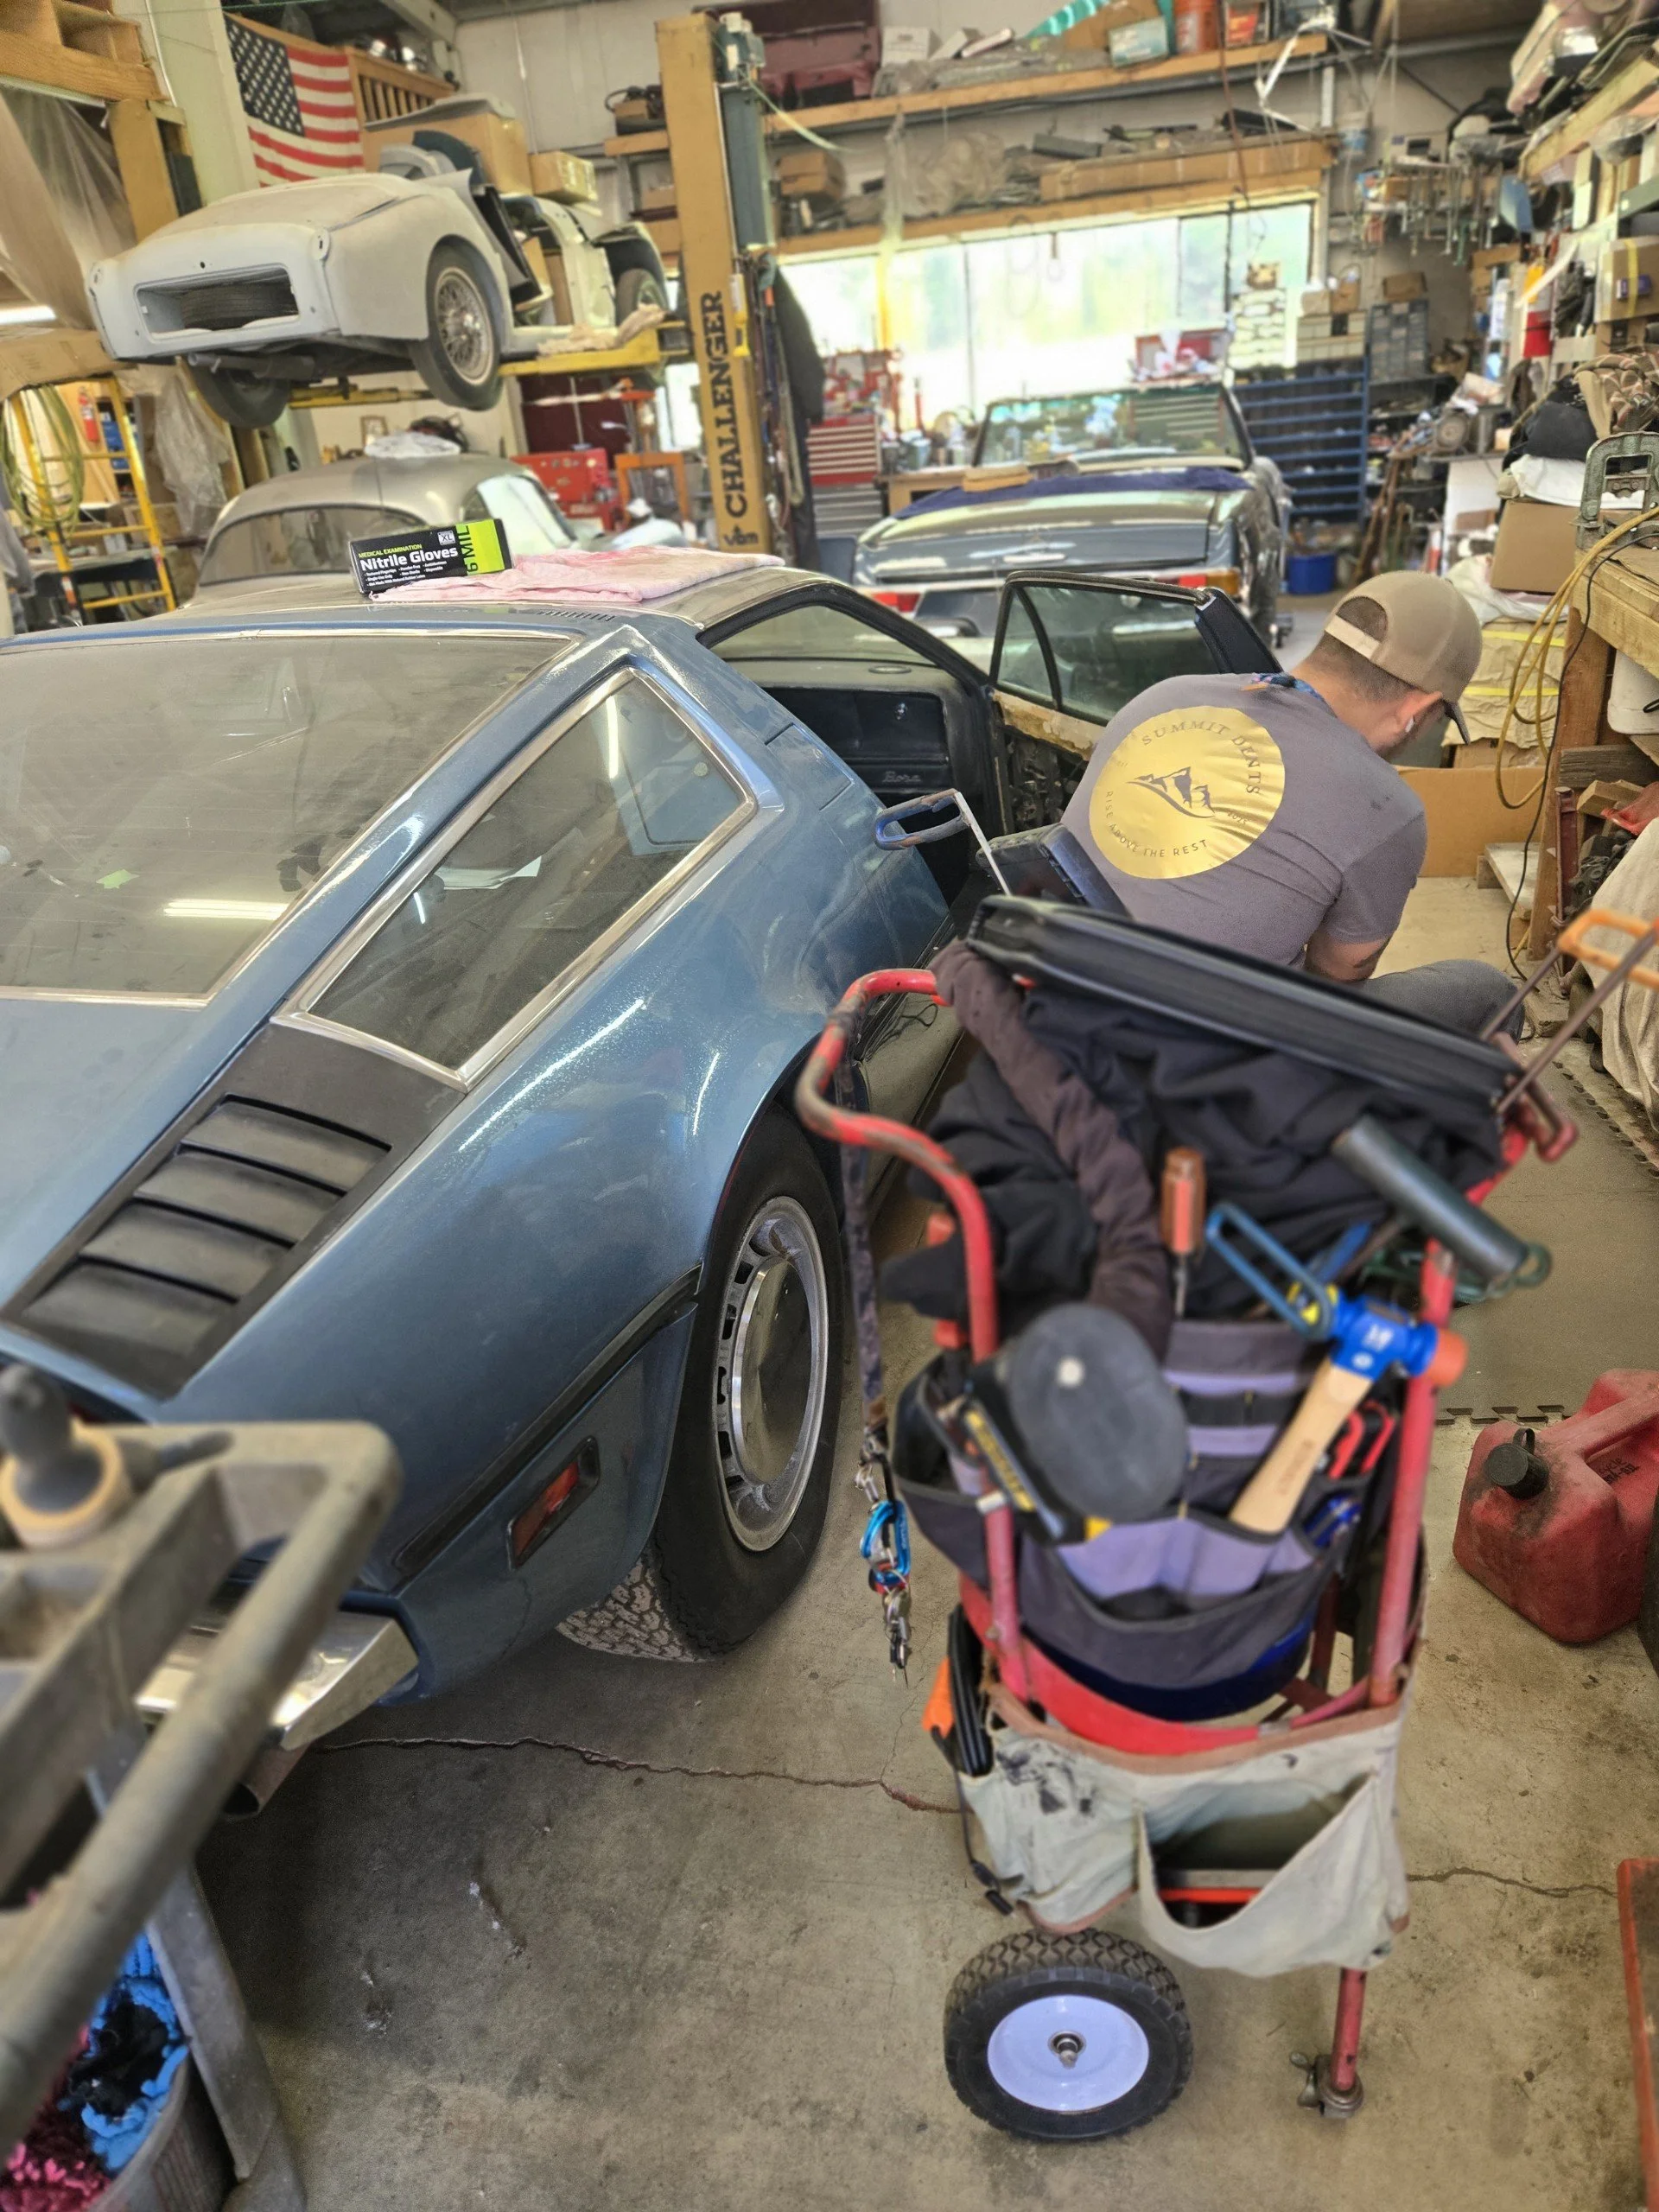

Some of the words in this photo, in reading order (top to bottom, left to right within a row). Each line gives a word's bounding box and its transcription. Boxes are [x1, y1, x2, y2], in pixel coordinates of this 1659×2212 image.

[701, 290, 748, 518] CHALLENGER
[358, 550, 384, 559] MEDICAL
[383, 543, 423, 555] EXAMINATION
[441, 534, 454, 543] XL
[458, 524, 476, 558] MIL
[359, 554, 407, 571] Nitrile
[410, 547, 459, 563] Gloves
[466, 562, 480, 572] 6
[1141, 720, 1231, 746] SUMMIT
[1231, 734, 1262, 795] DENTS
[1109, 823, 1140, 853] ABOVE
[1143, 847, 1166, 858] THE
[1173, 839, 1208, 856] REST
